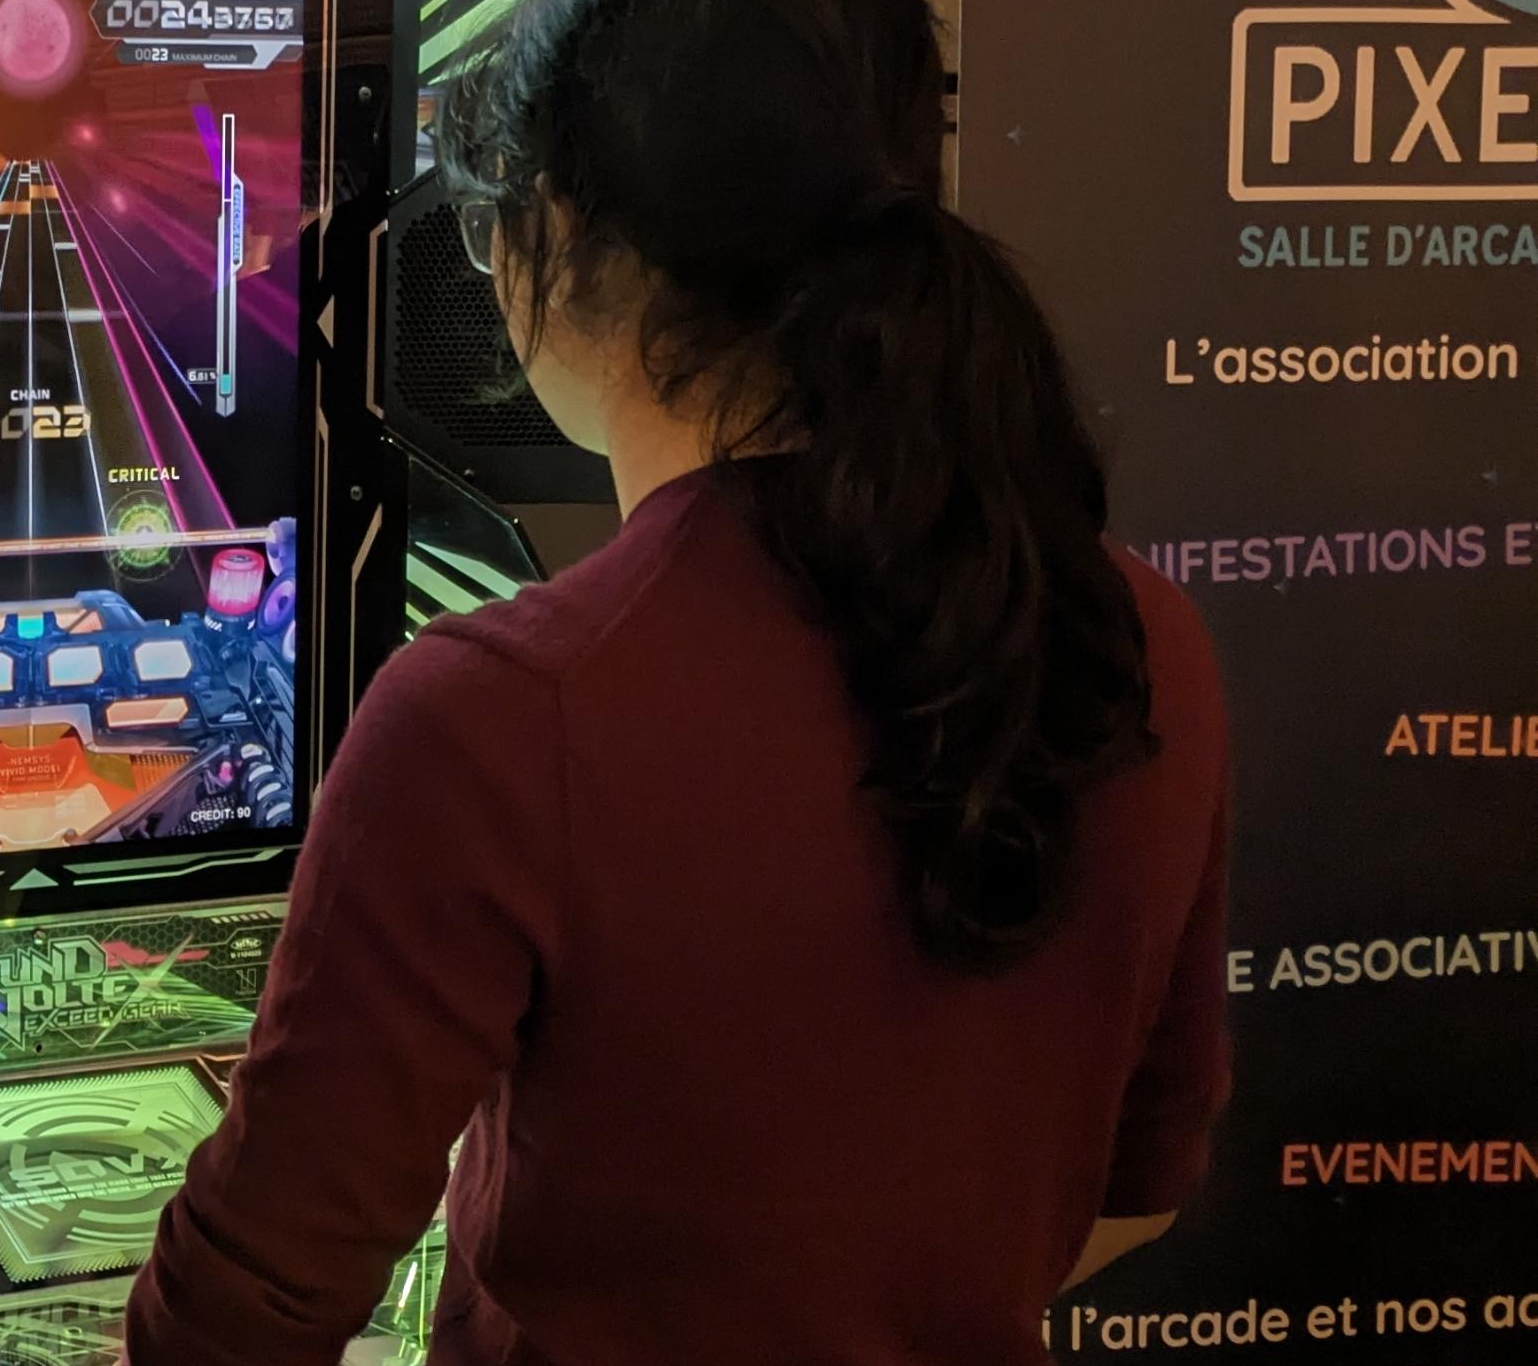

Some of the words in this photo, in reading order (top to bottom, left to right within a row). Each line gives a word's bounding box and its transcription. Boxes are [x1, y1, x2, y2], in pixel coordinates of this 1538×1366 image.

[134, 47, 169, 62] 0023
[1270, 46, 1538, 164] PIXE
[1238, 225, 1370, 268] SALLE
[1386, 224, 1538, 267] D'ARCA
[1165, 334, 1519, 385] L'association
[10, 389, 51, 401] CHAIN
[108, 466, 180, 484] CRITICAL
[1504, 521, 1538, 566] E
[190, 808, 234, 823] CREDIT:
[24, 1006, 113, 1032] EXCEED
[1281, 1140, 1538, 1187] EVENEMEN
[1071, 1299, 1290, 1351] l'arcade
[1307, 1297, 1358, 1338] et
[1376, 1291, 1466, 1334] nos
